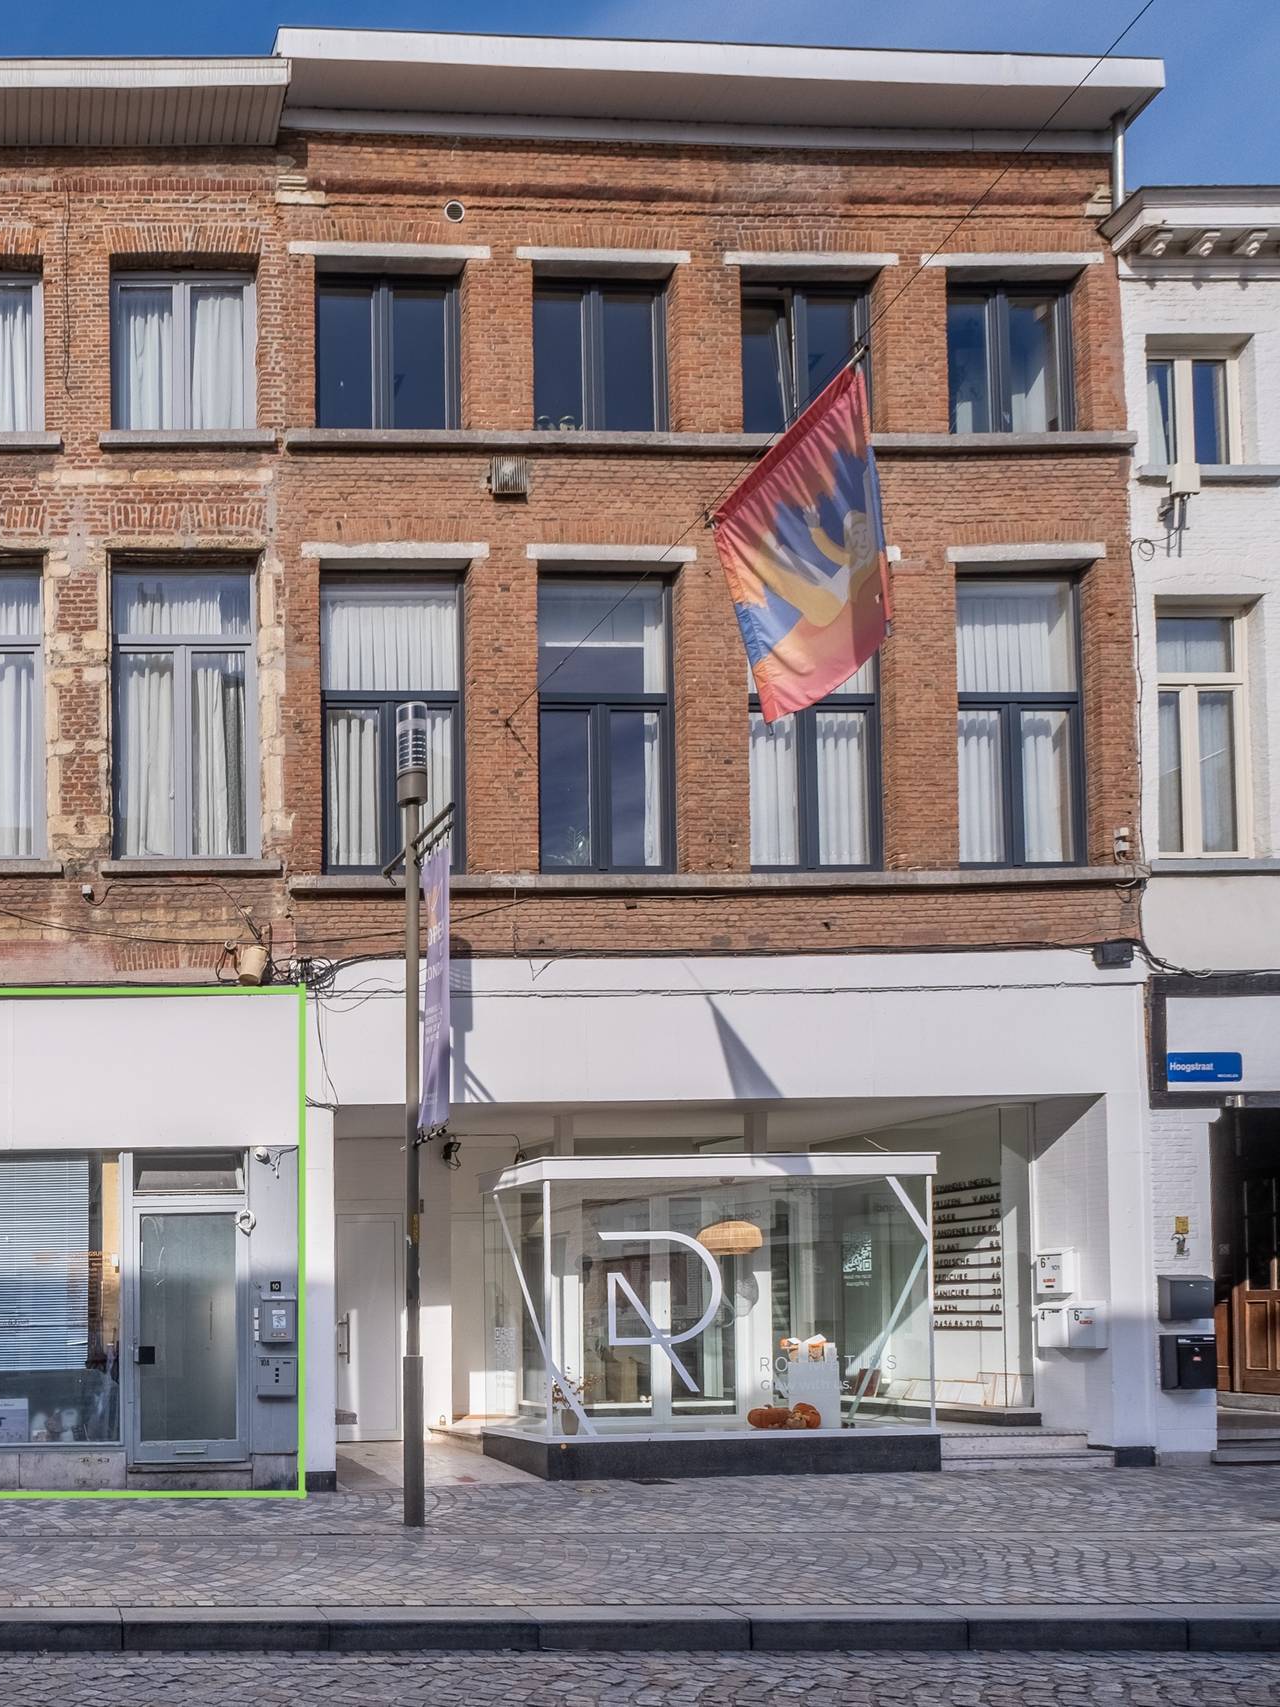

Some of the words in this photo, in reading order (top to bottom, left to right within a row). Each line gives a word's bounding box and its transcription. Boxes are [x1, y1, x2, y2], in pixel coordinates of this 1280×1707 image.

[1169, 1062, 1214, 1073] Hoogstraat
[1040, 1257, 1046, 1268] 6
[271, 1282, 280, 1290] 10
[1074, 1310, 1080, 1321] 6
